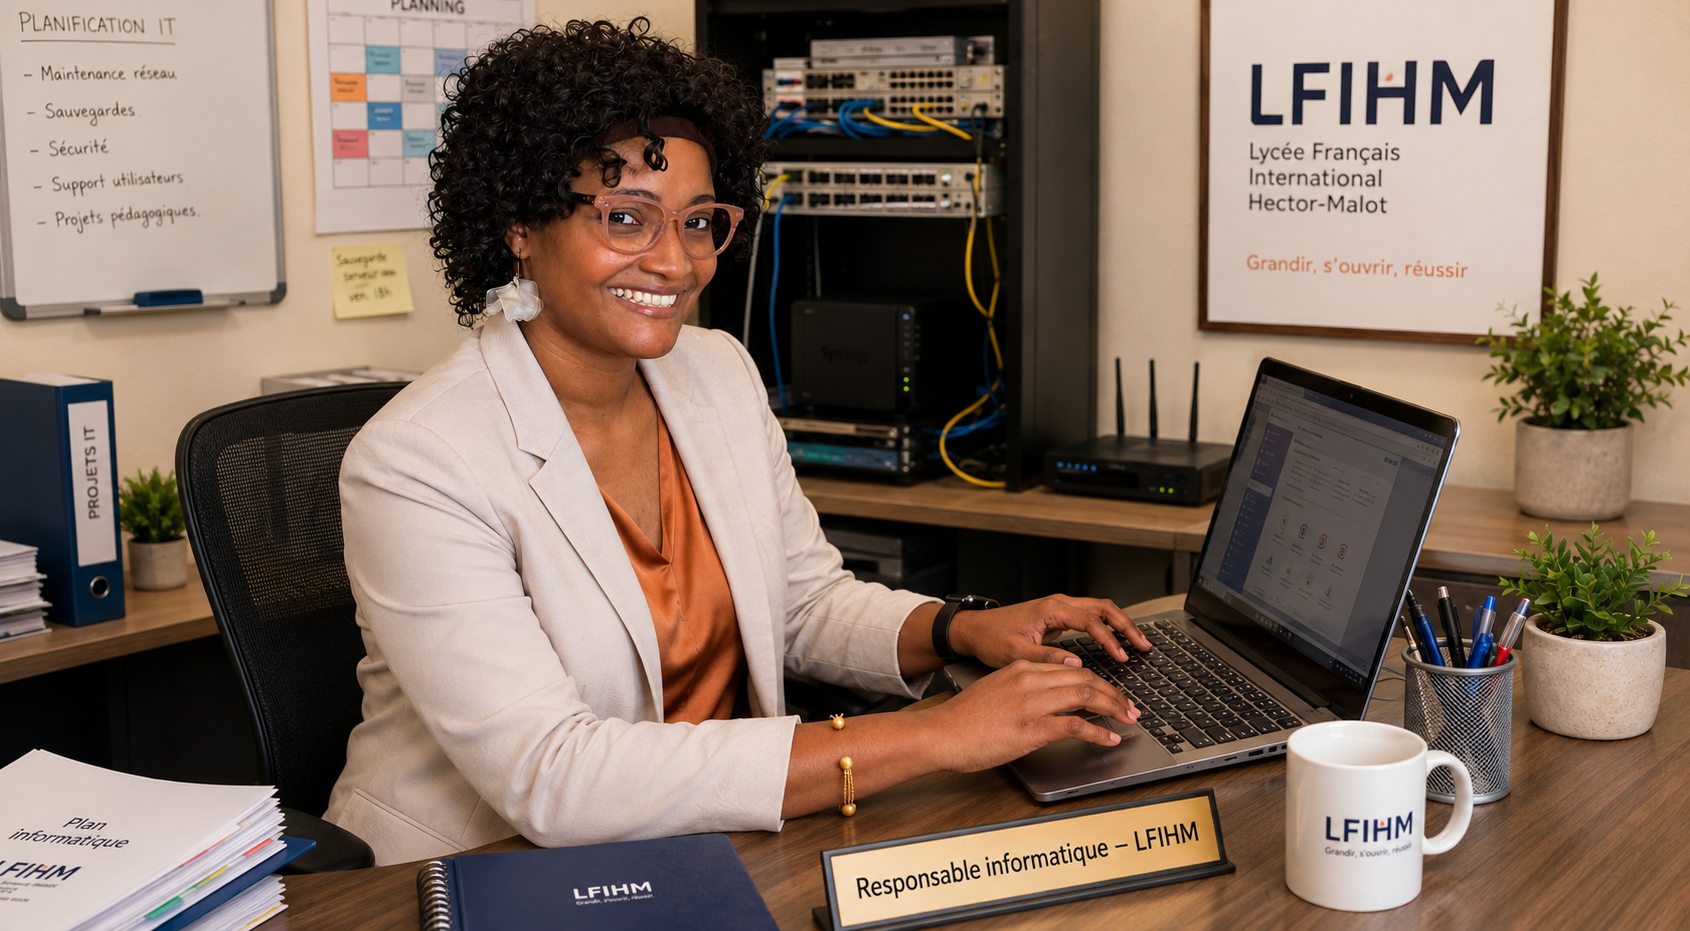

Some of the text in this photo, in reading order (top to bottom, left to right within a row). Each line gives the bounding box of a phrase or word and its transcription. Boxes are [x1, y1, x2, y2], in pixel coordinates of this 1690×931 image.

[391, 0, 466, 15] PLANNING
[19, 11, 176, 35] PLANIFICATION IT
[41, 65, 126, 81] Maintenance
[1251, 59, 1495, 125] LFIHM
[49, 138, 109, 157] Sécurité
[1250, 142, 1400, 166] Lycée Français
[52, 174, 105, 197] Support
[113, 171, 184, 187] utilisateurs
[1250, 168, 1382, 187] International
[1249, 193, 1388, 214] Hector-Malot
[55, 210, 103, 234] Projets
[1246, 254, 1468, 278] Grandir, s'ouvrir, réussir
[83, 426, 101, 519] PROJETS IT
[62, 817, 107, 831] Plan
[1325, 811, 1413, 843] LFIHM
[8, 828, 129, 850] informatique
[856, 859, 981, 899] Responsable
[985, 842, 1109, 876] informatique
[1134, 821, 1200, 852] LFIHM
[1324, 846, 1358, 859] Grandir,
[0, 860, 82, 881] FIHM
[573, 881, 653, 900] LFIHM
